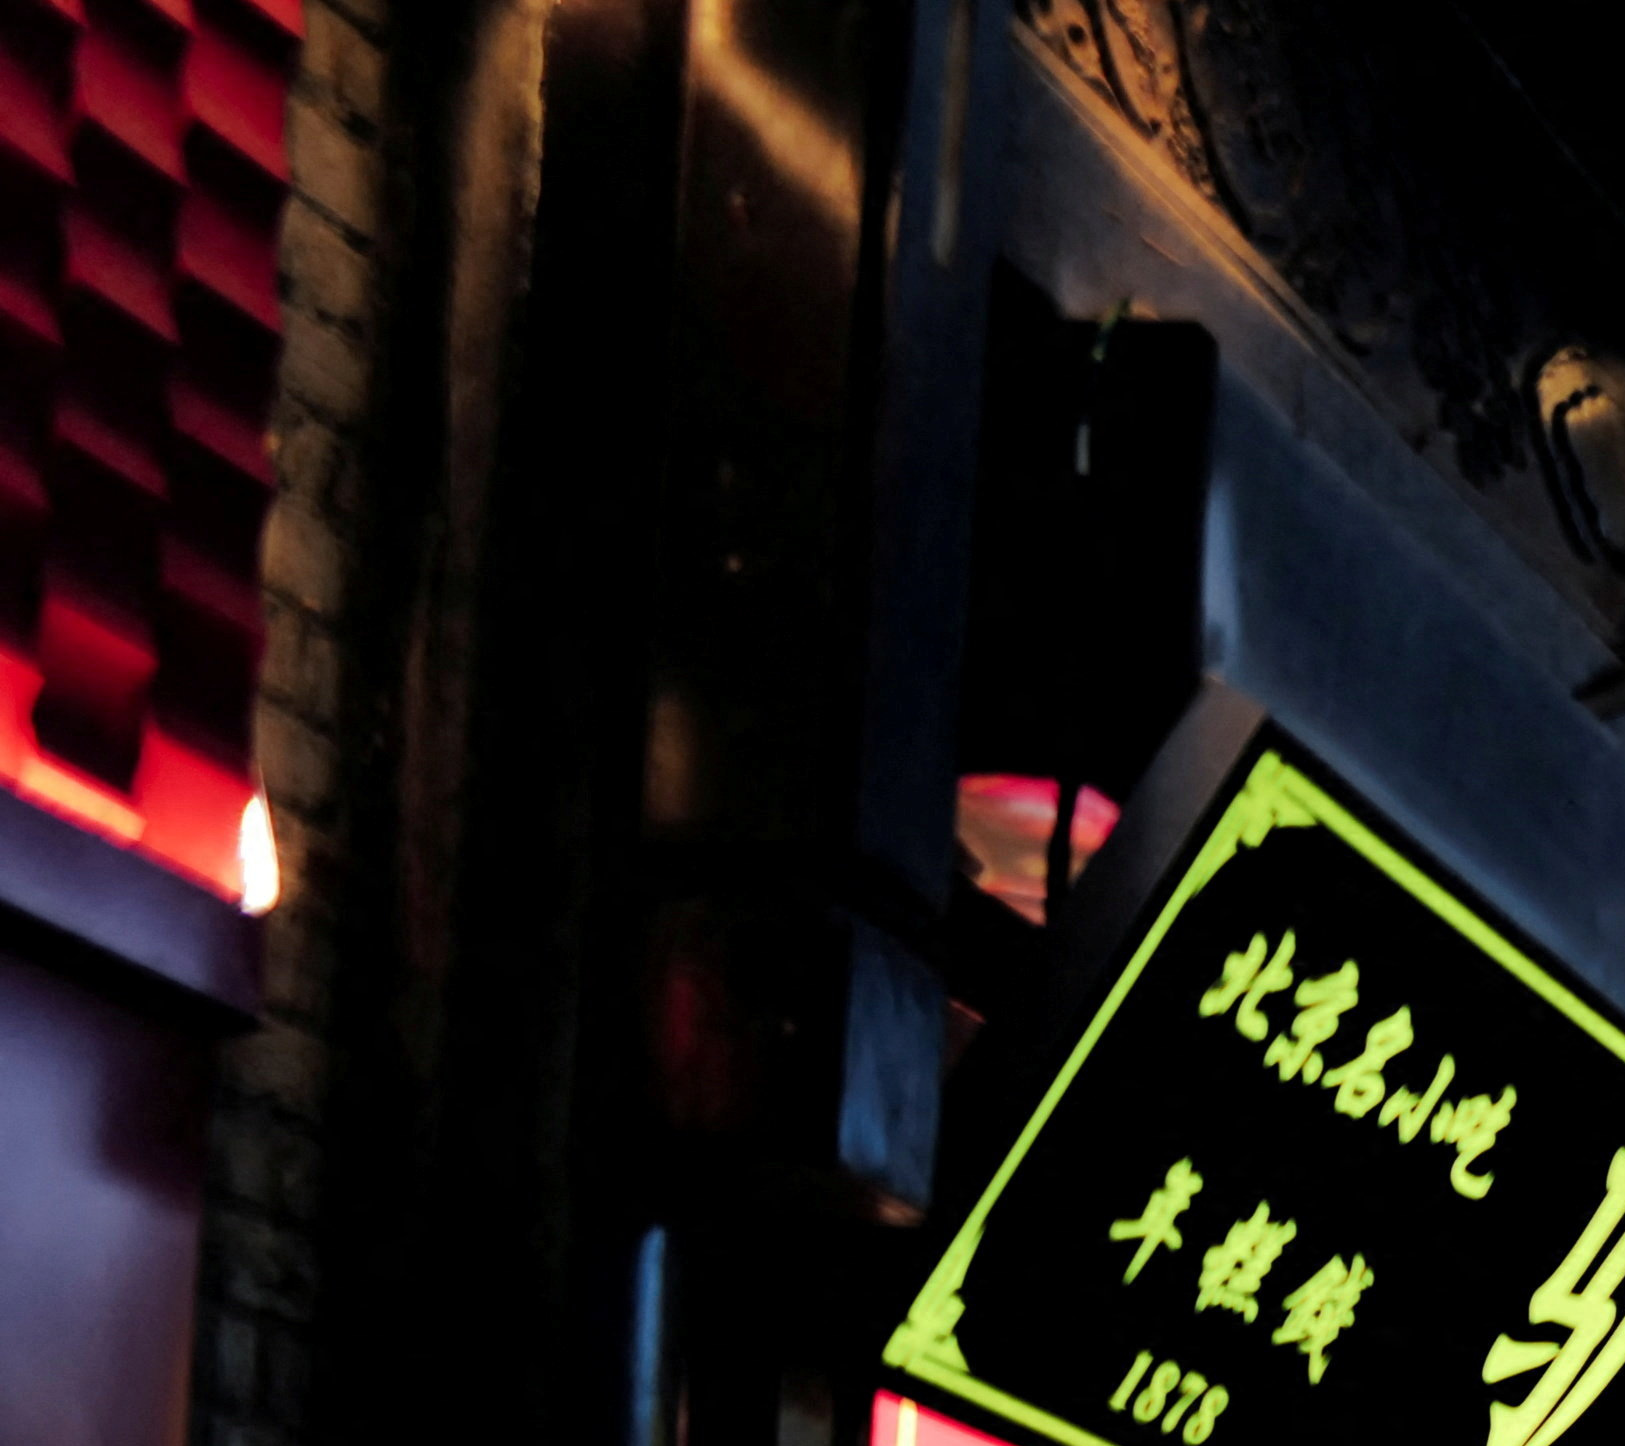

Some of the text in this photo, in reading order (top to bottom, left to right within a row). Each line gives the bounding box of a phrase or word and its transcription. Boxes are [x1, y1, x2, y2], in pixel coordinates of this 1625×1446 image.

[1198, 927, 1518, 1201] 北京名小吃
[1107, 1349, 1229, 1446] 1878
